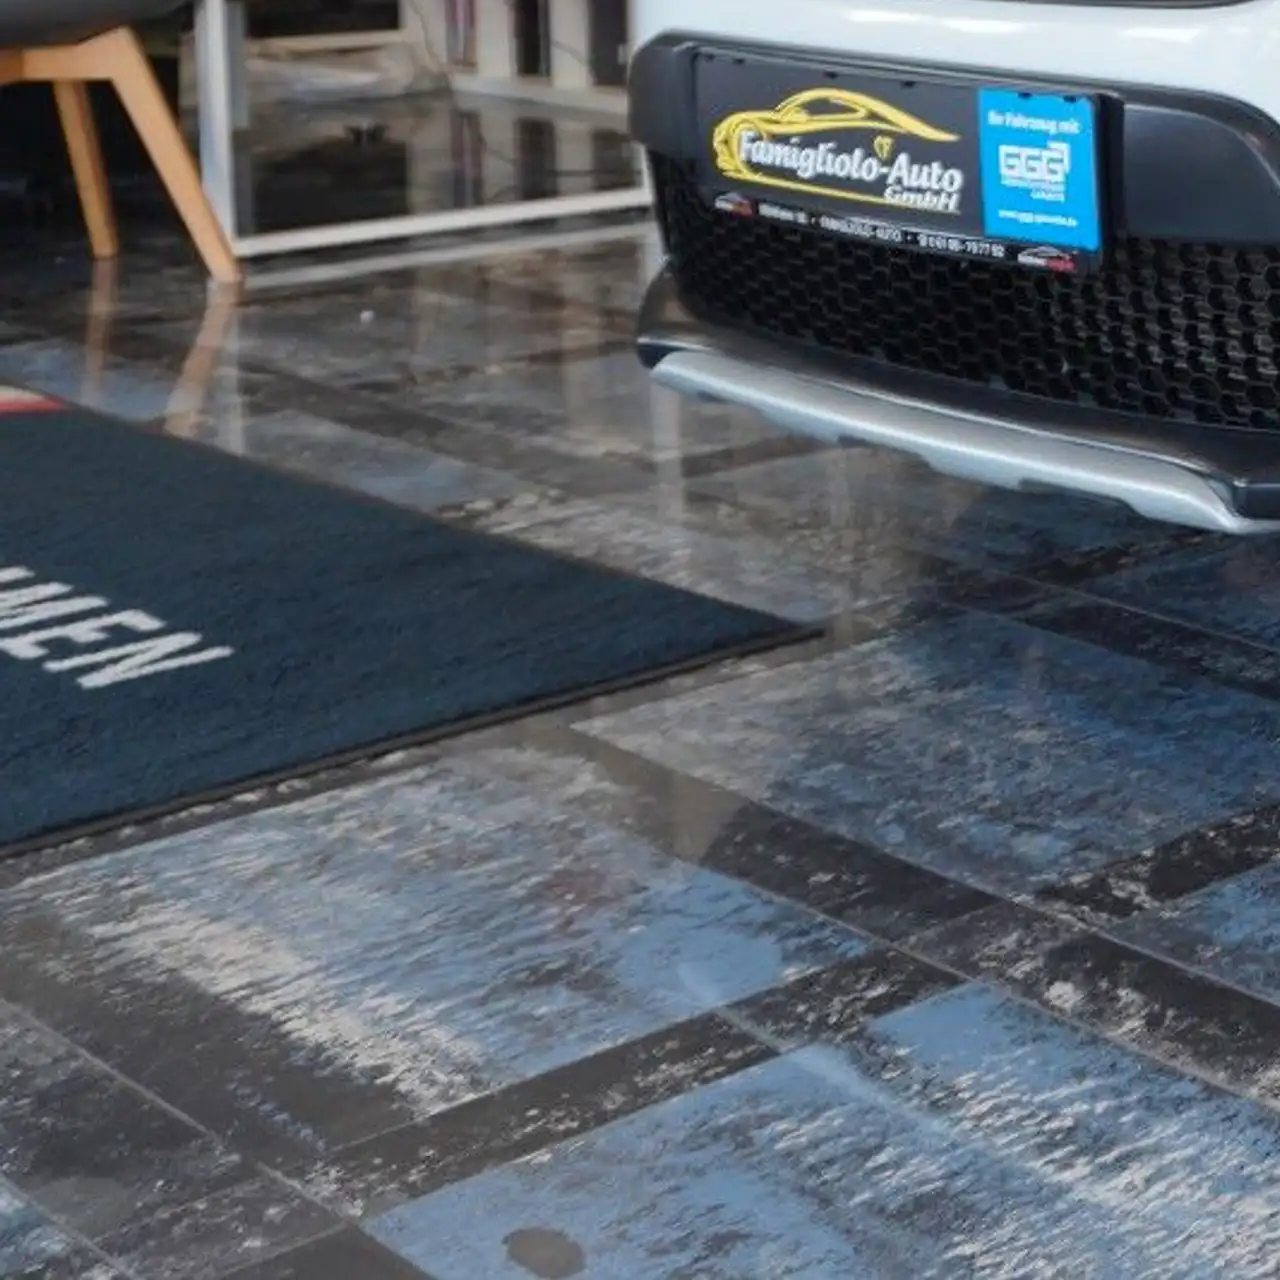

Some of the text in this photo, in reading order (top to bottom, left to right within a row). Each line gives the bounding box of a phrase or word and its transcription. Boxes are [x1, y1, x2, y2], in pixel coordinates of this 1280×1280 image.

[740, 130, 964, 192] Famigliolo-Auto
[884, 185, 961, 212] GmbH
[0, 566, 235, 690] MEN
